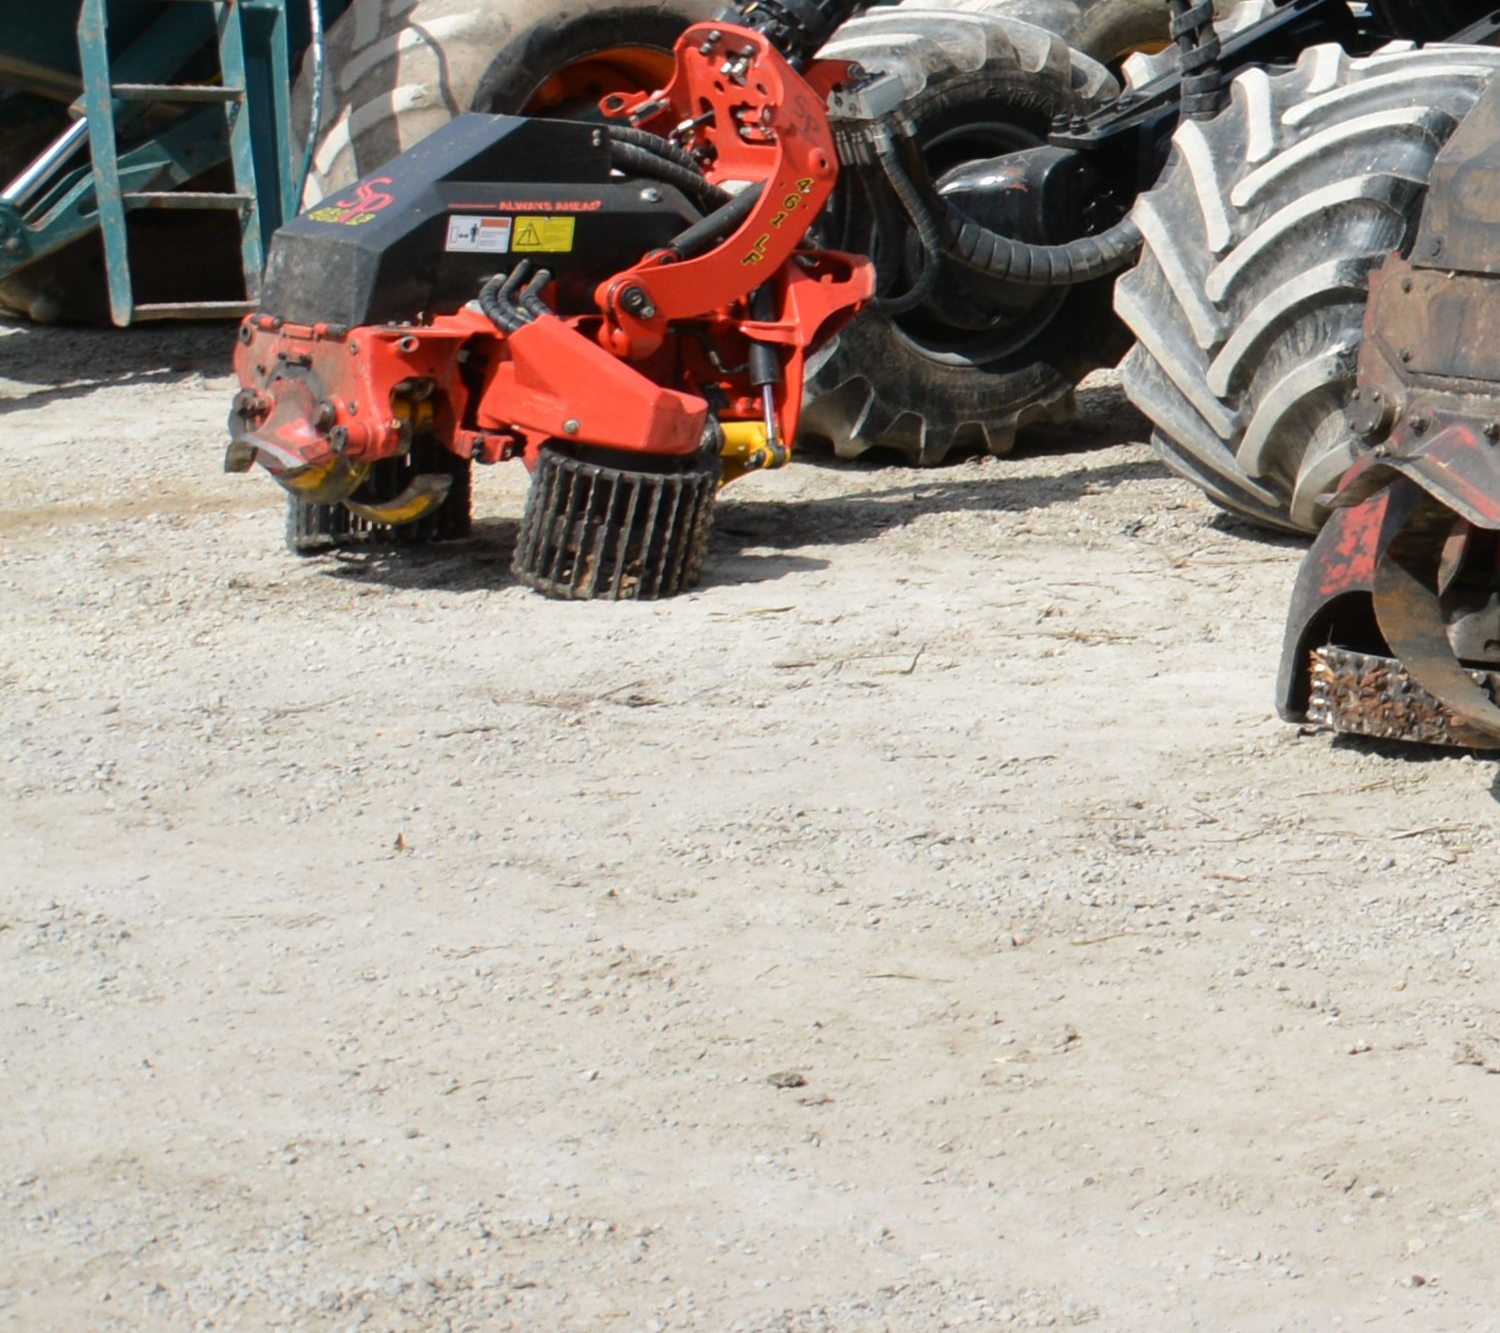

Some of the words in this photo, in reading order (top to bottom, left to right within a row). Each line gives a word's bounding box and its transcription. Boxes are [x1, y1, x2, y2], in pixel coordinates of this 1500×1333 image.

[336, 176, 394, 223] SP
[499, 200, 553, 211] ALWAYS
[555, 200, 602, 212] AHEAD
[769, 177, 814, 229] 461
[740, 233, 770, 265] LF
